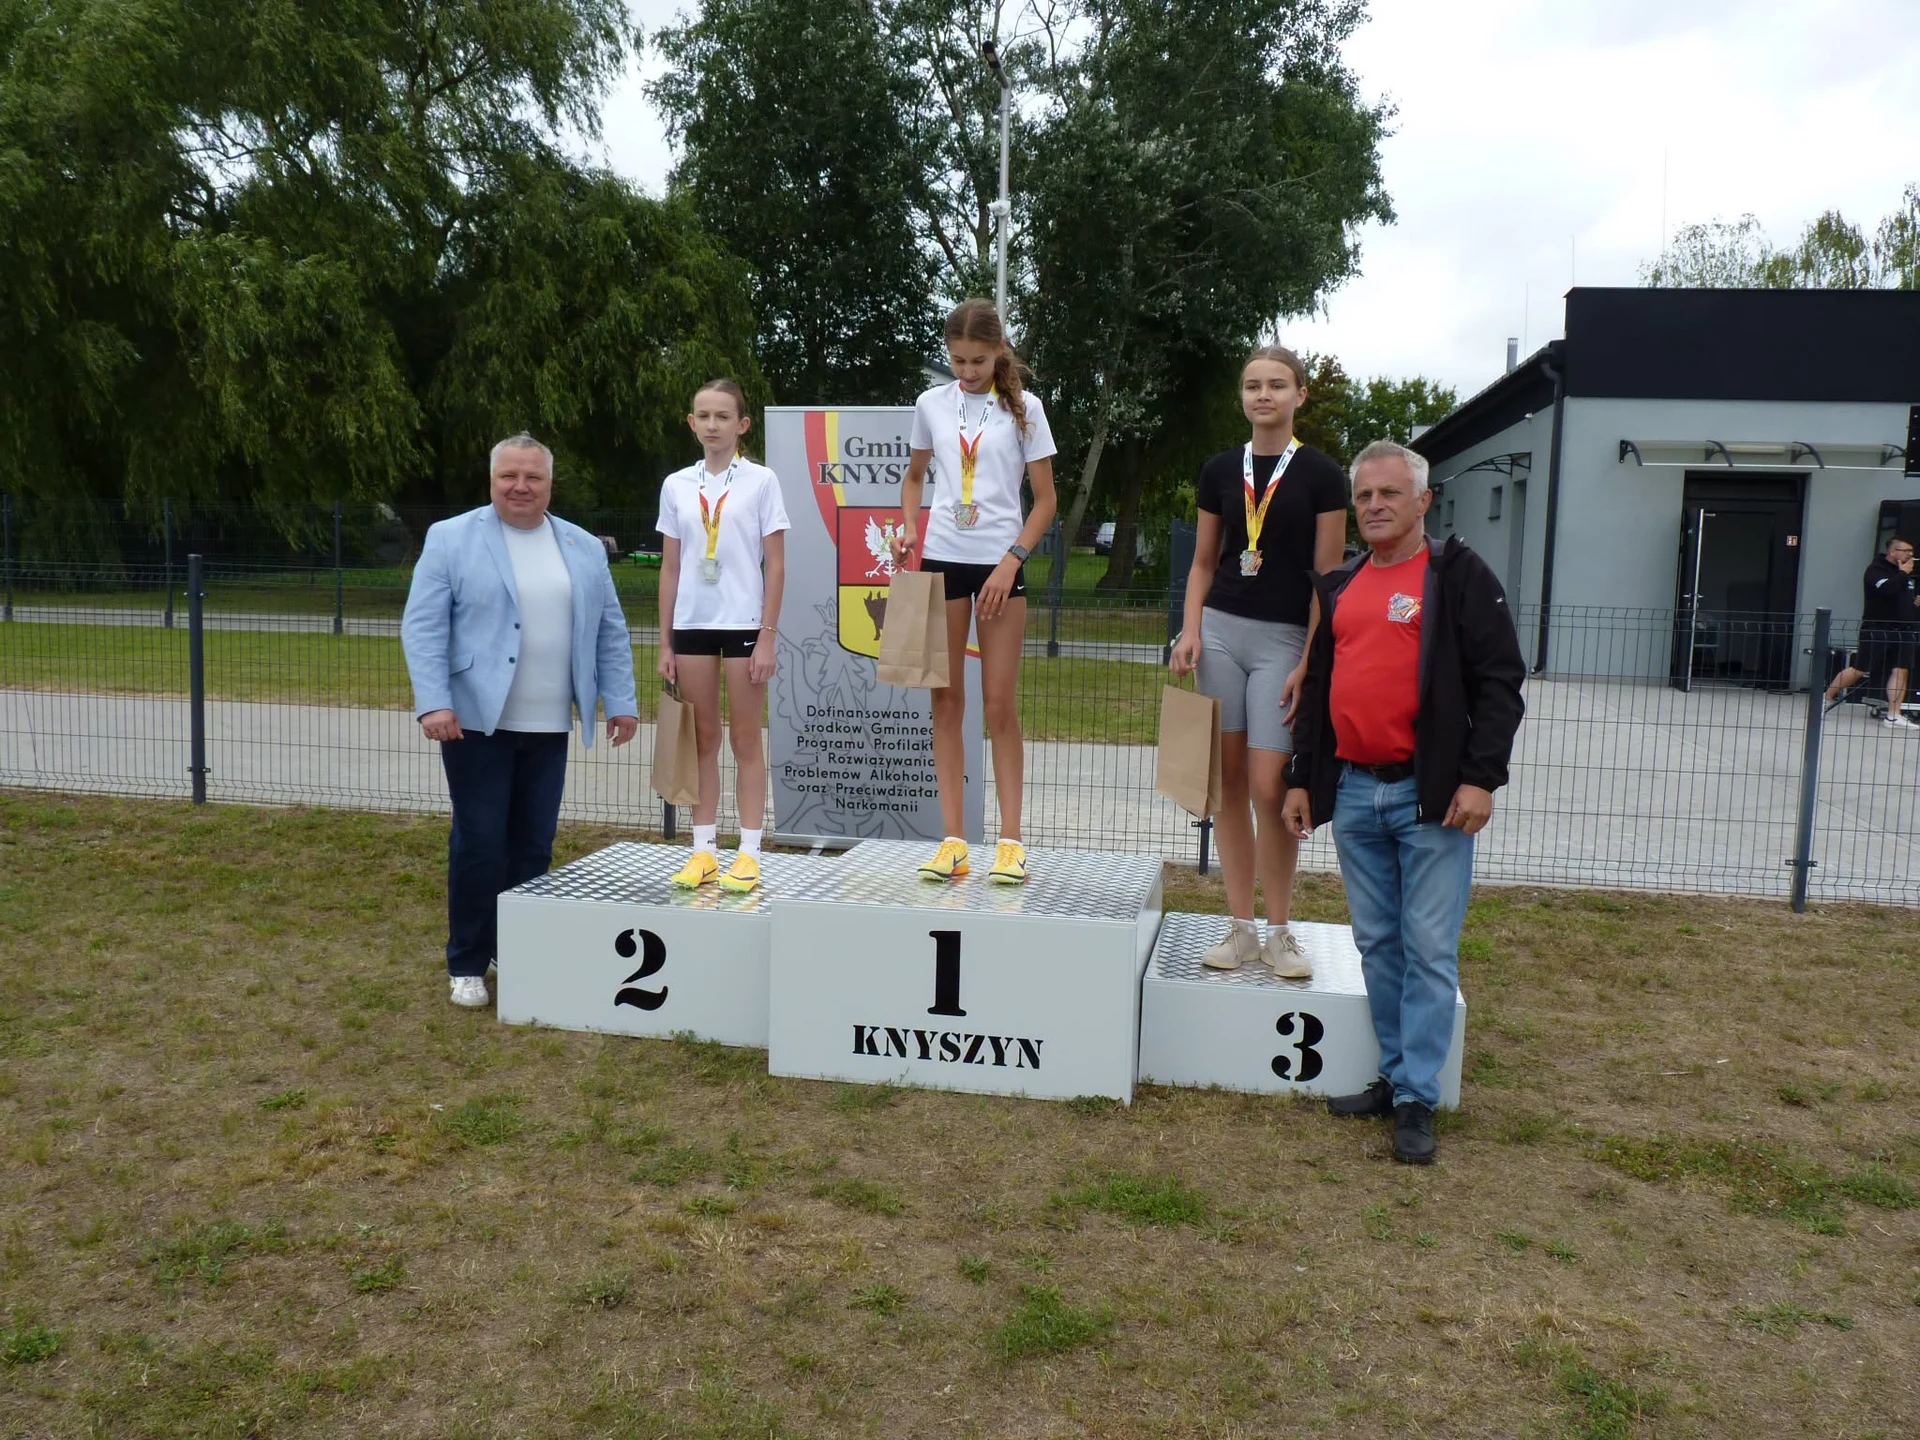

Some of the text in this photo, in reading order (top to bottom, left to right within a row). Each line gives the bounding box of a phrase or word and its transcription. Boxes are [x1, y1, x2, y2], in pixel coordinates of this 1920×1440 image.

[844, 435, 936, 458] Gmi
[818, 463, 936, 485] KNYSY
[806, 705, 920, 720] Dofinansowano
[871, 722, 934, 736] Gminne
[797, 736, 934, 752] Programu Profilakt
[815, 752, 819, 763] i
[784, 766, 861, 780] Problemów
[797, 784, 827, 793] oraz
[835, 798, 918, 813] Narkomanii
[614, 929, 668, 1012] 2
[928, 931, 966, 1016] 1
[853, 1025, 1043, 1069] KNYSZYN
[1271, 1012, 1325, 1083] 3
